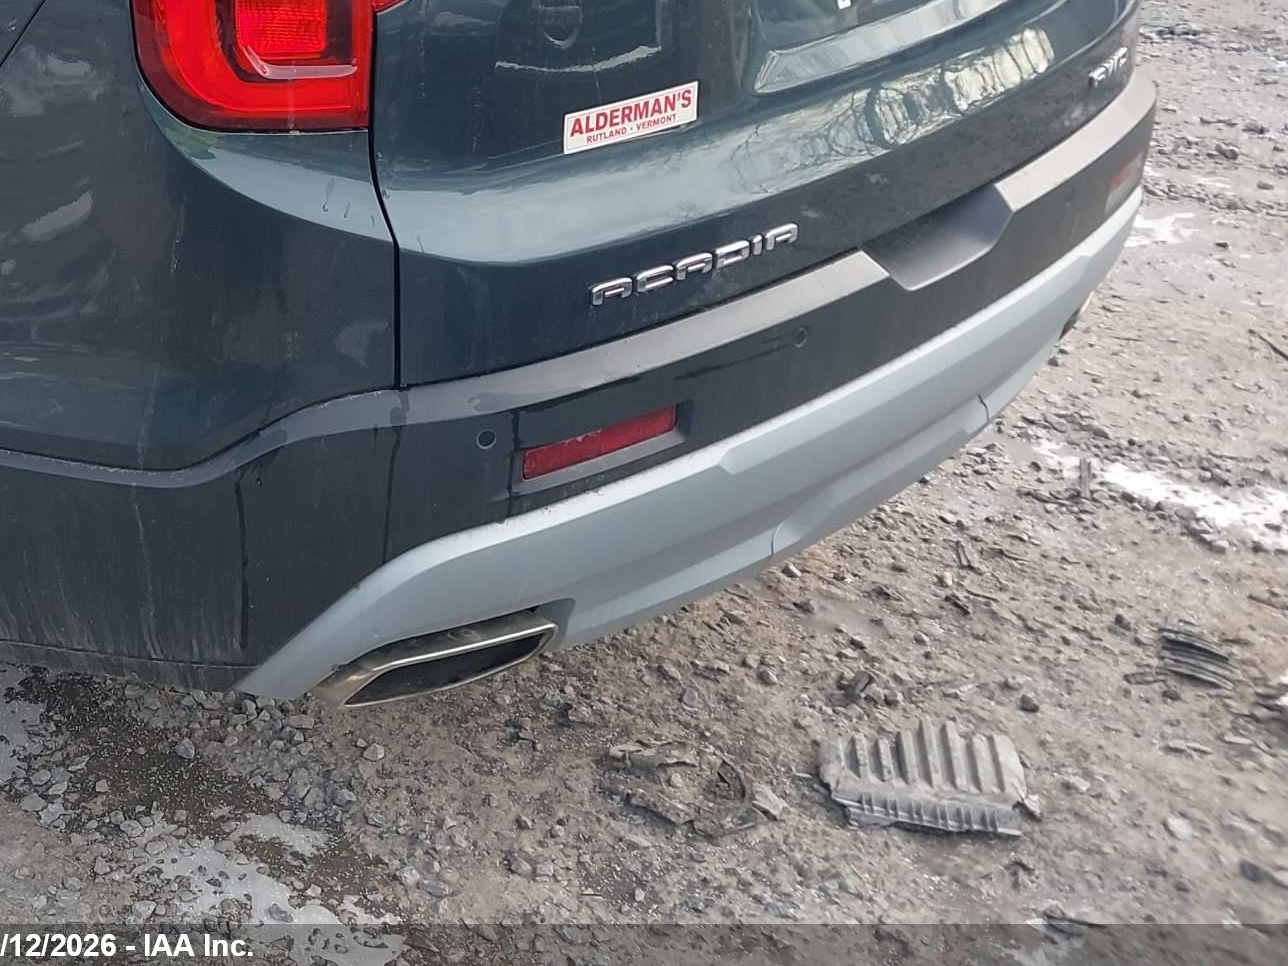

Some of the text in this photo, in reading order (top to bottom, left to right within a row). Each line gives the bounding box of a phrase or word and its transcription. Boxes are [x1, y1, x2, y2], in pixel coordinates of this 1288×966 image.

[570, 89, 692, 138] ALDERMAN'S
[586, 113, 677, 144] RUTLAND VERMONT
[591, 222, 799, 306] ACADIA
